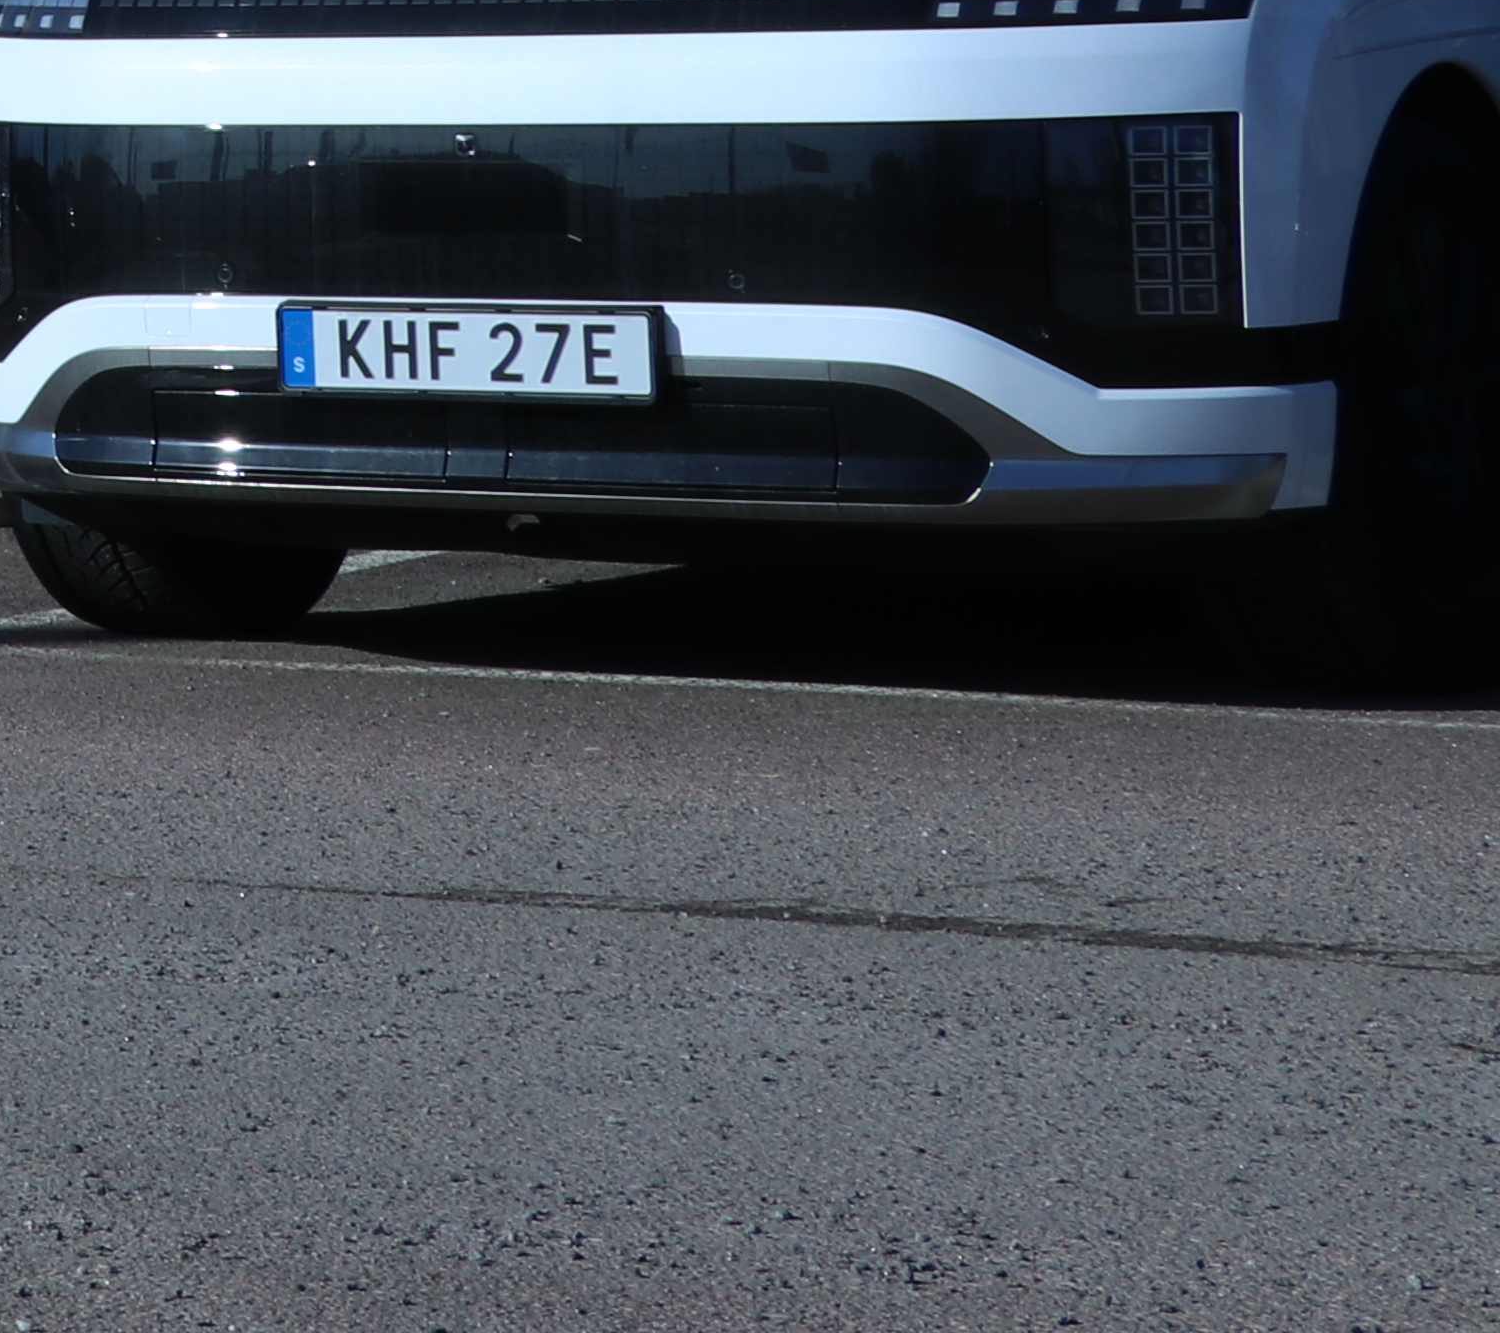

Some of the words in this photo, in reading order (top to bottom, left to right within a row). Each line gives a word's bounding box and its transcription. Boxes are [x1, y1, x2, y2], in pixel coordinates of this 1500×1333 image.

[293, 356, 306, 374] S
[337, 319, 461, 382] KHF
[488, 322, 620, 386] 27E
